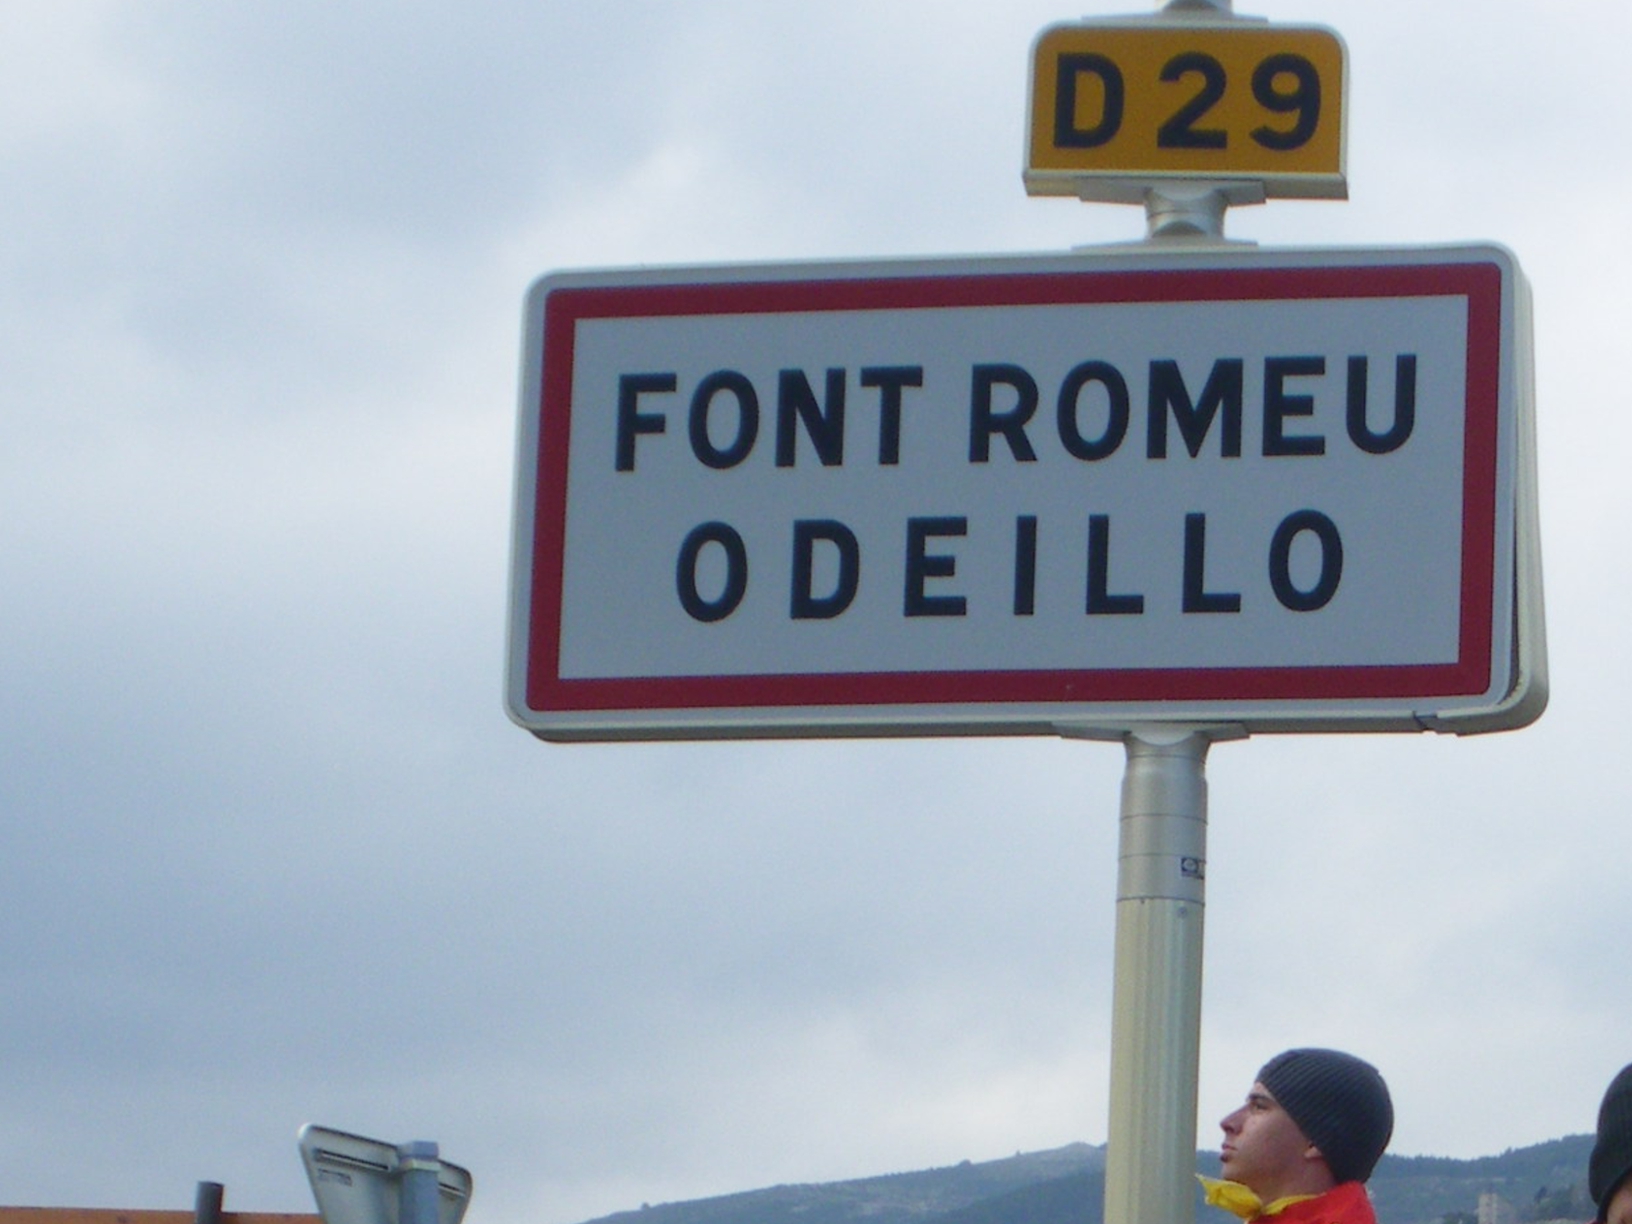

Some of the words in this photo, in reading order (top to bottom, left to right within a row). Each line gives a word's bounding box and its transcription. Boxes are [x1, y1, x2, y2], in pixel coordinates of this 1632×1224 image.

[1053, 52, 1125, 149] D
[1156, 51, 1321, 151] 29
[614, 365, 924, 472] FONT
[967, 353, 1418, 464] ROMEU
[674, 509, 1344, 623] ODEILLO
